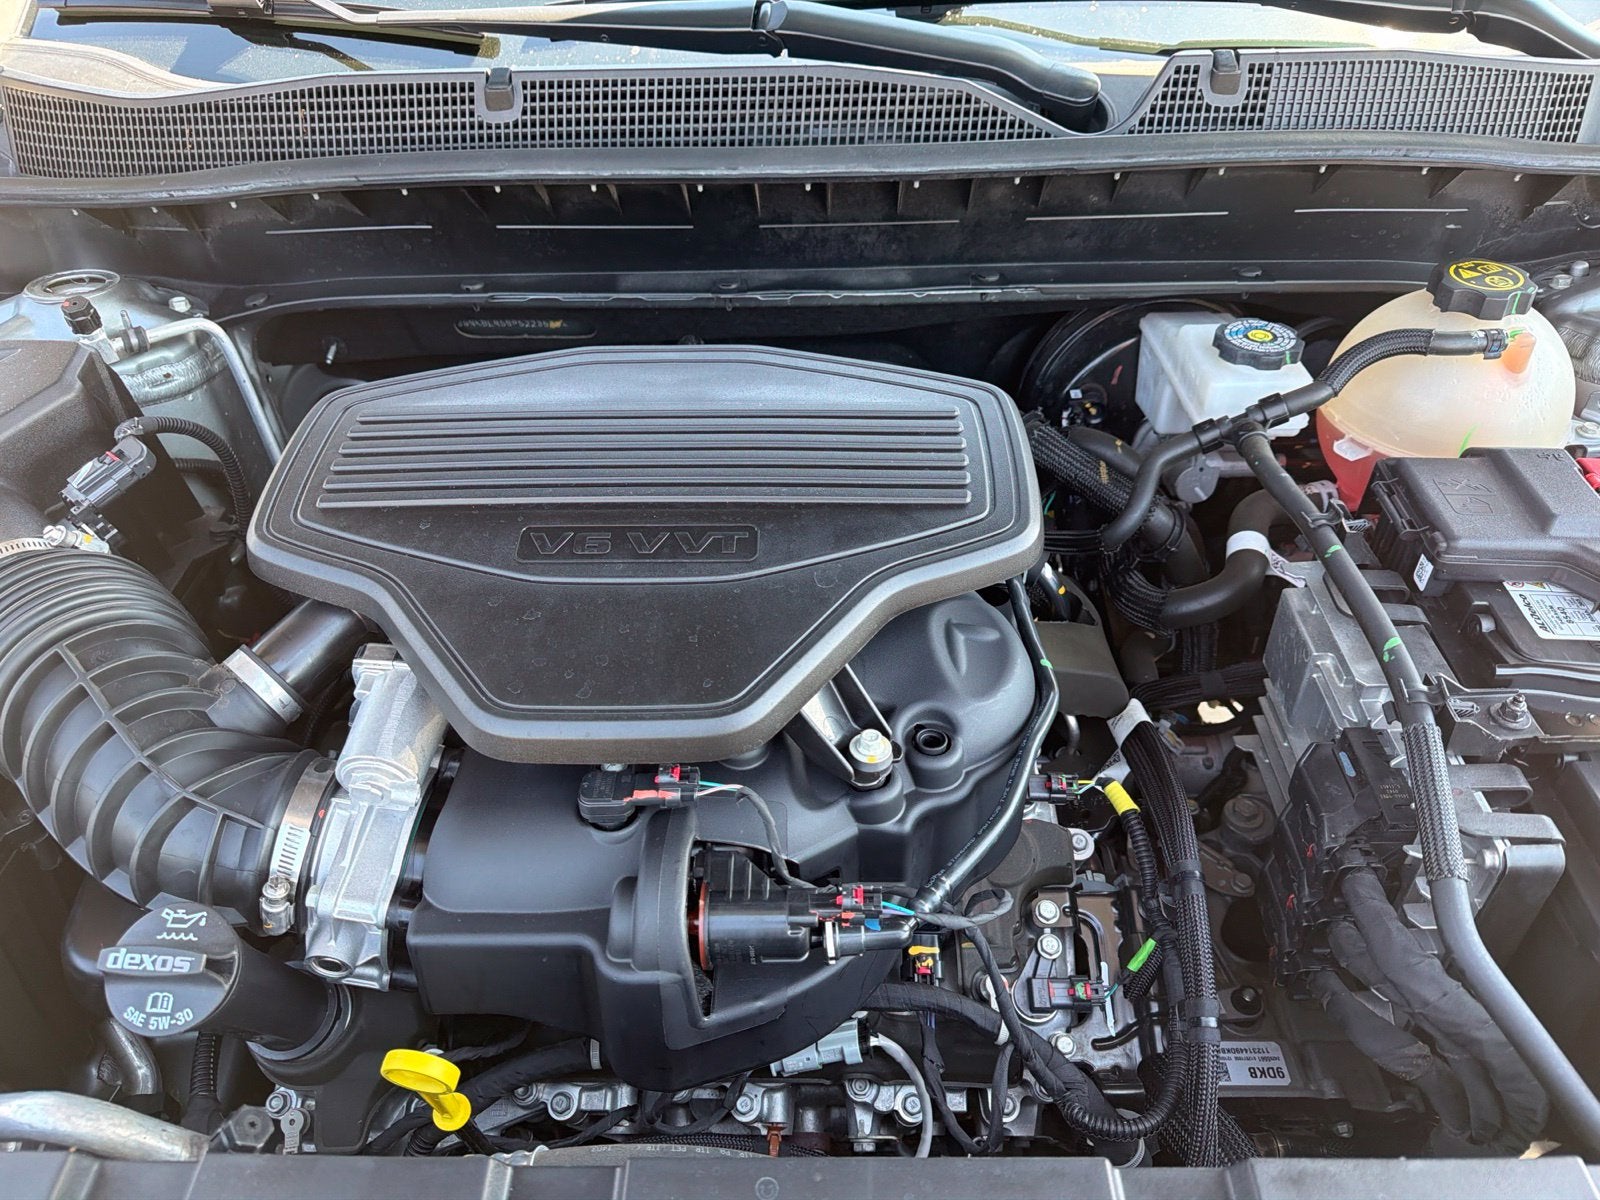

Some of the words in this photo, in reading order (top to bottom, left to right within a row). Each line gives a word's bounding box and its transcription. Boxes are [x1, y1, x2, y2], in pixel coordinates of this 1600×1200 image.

[530, 532, 612, 554] V6
[626, 532, 749, 554] VVT
[106, 948, 191, 973] dexos
[123, 1006, 147, 1028] SAE
[149, 1008, 194, 1031] 5W-30
[1248, 1066, 1286, 1079] 9DKB
